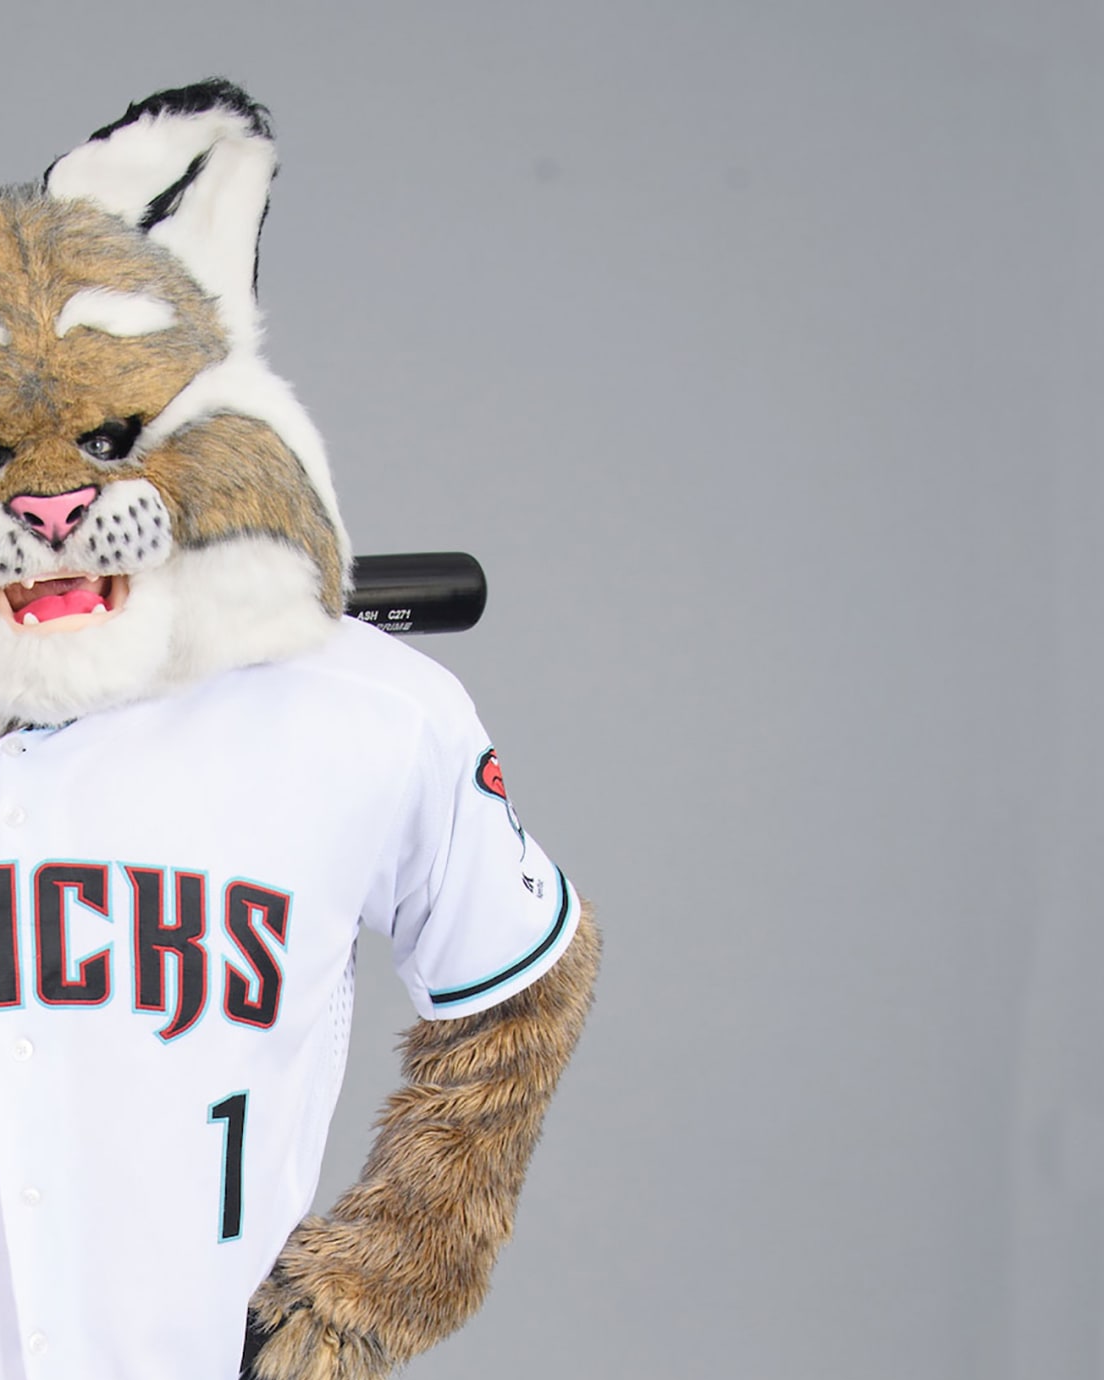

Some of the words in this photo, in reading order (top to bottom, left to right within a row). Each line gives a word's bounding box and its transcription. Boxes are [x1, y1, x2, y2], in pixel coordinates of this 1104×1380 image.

[357, 610, 379, 621] ASH
[388, 609, 412, 620] C271
[207, 1089, 249, 1244] 1
